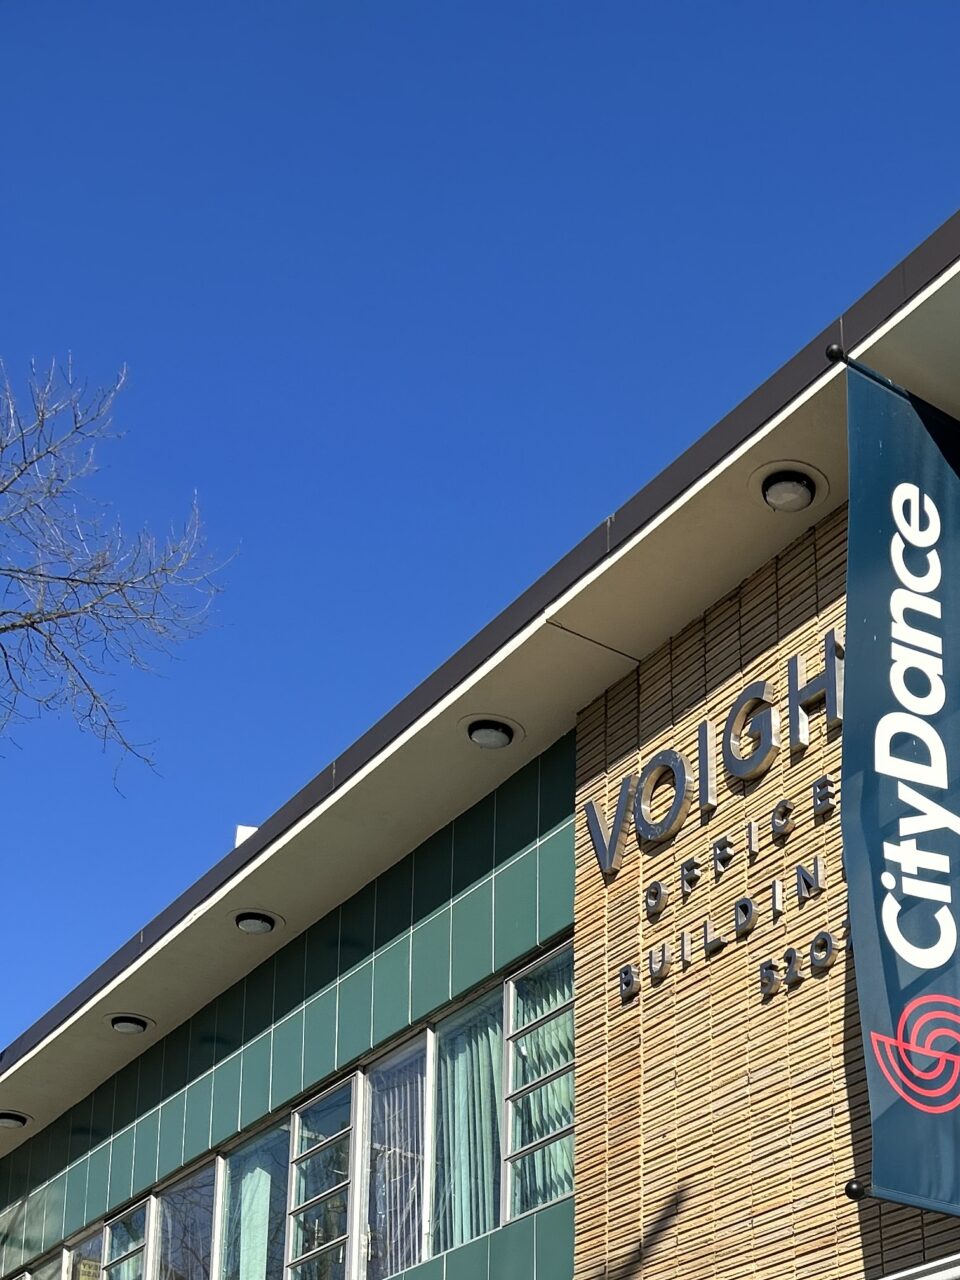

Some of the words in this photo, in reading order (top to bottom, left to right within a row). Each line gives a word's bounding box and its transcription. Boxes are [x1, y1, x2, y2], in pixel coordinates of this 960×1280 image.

[646, 774, 836, 915] OFFICE
[620, 855, 846, 999] BUILDIN
[760, 922, 848, 996] 520
